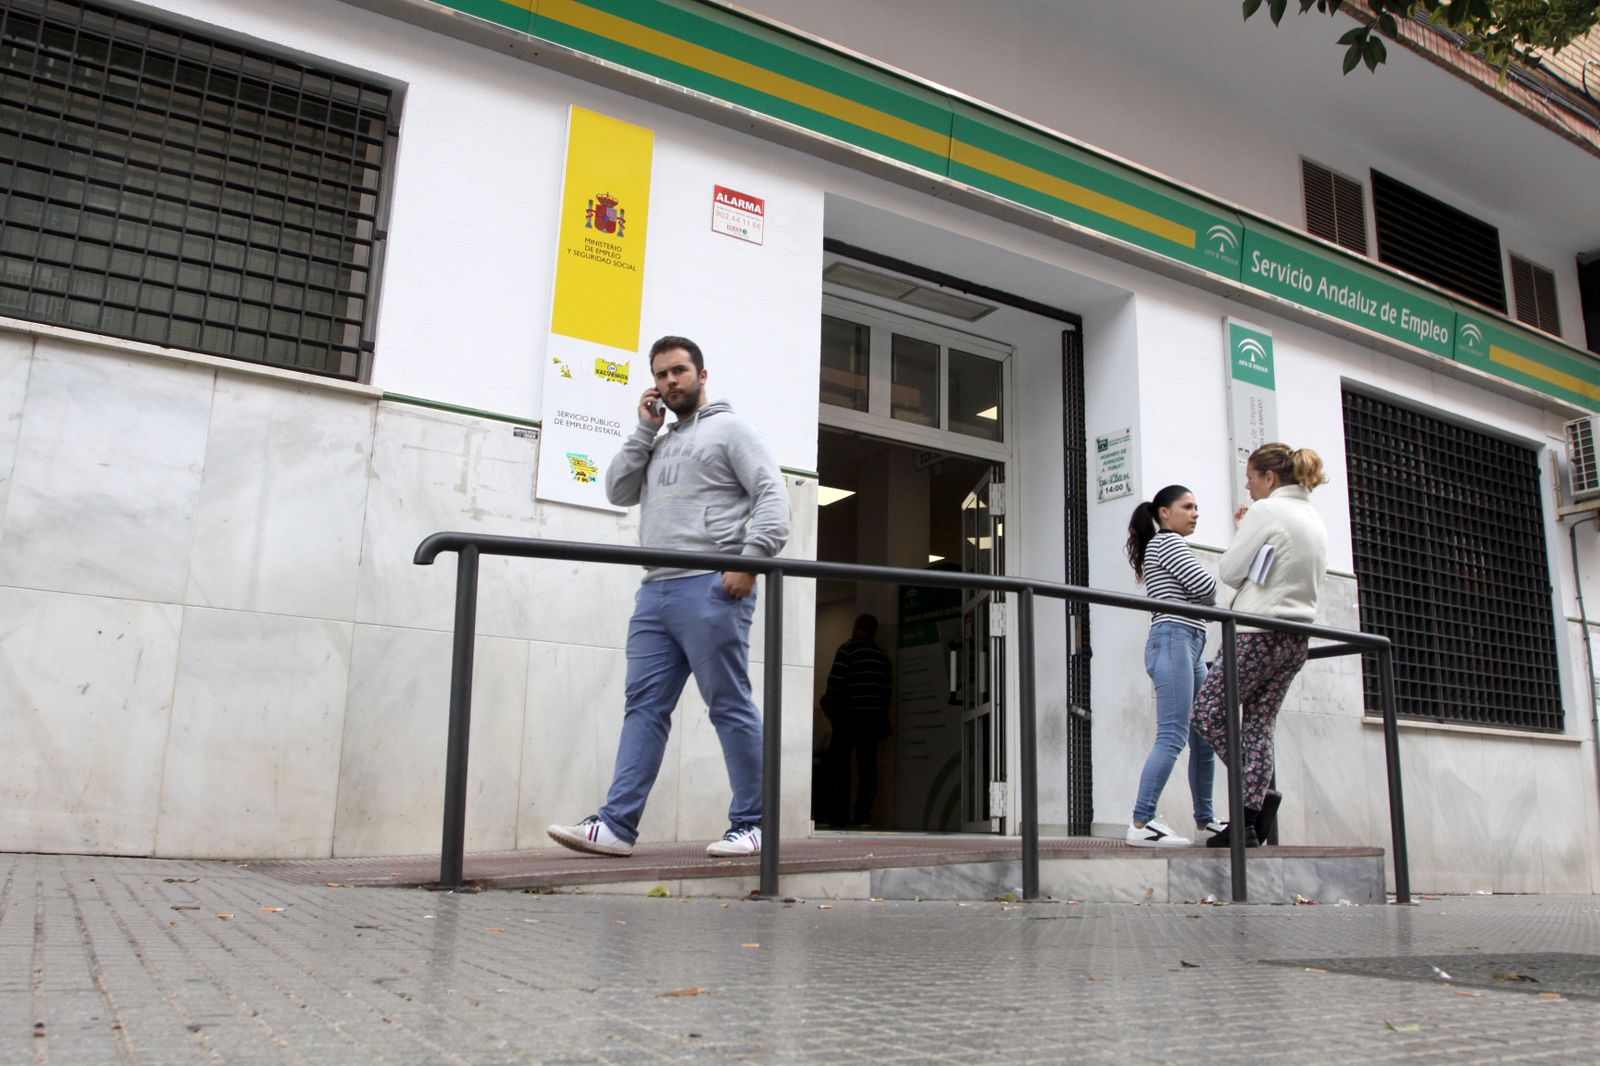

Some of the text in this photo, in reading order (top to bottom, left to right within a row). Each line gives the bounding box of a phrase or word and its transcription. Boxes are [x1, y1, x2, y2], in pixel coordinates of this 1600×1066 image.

[715, 193, 762, 214] ALARMA
[584, 237, 622, 253] MINISTERIO
[584, 244, 621, 260] DE EMPLEO
[573, 249, 611, 265] SEGURIDAD
[613, 260, 637, 272] SOCIAL
[1251, 250, 1449, 344] Servicio Andaluz de Empleo
[557, 410, 589, 422] SERVICIO
[554, 418, 622, 438] DE EMPLEO ESTATAL
[657, 463, 680, 487] ALI
[1105, 483, 1124, 494] 14:00
